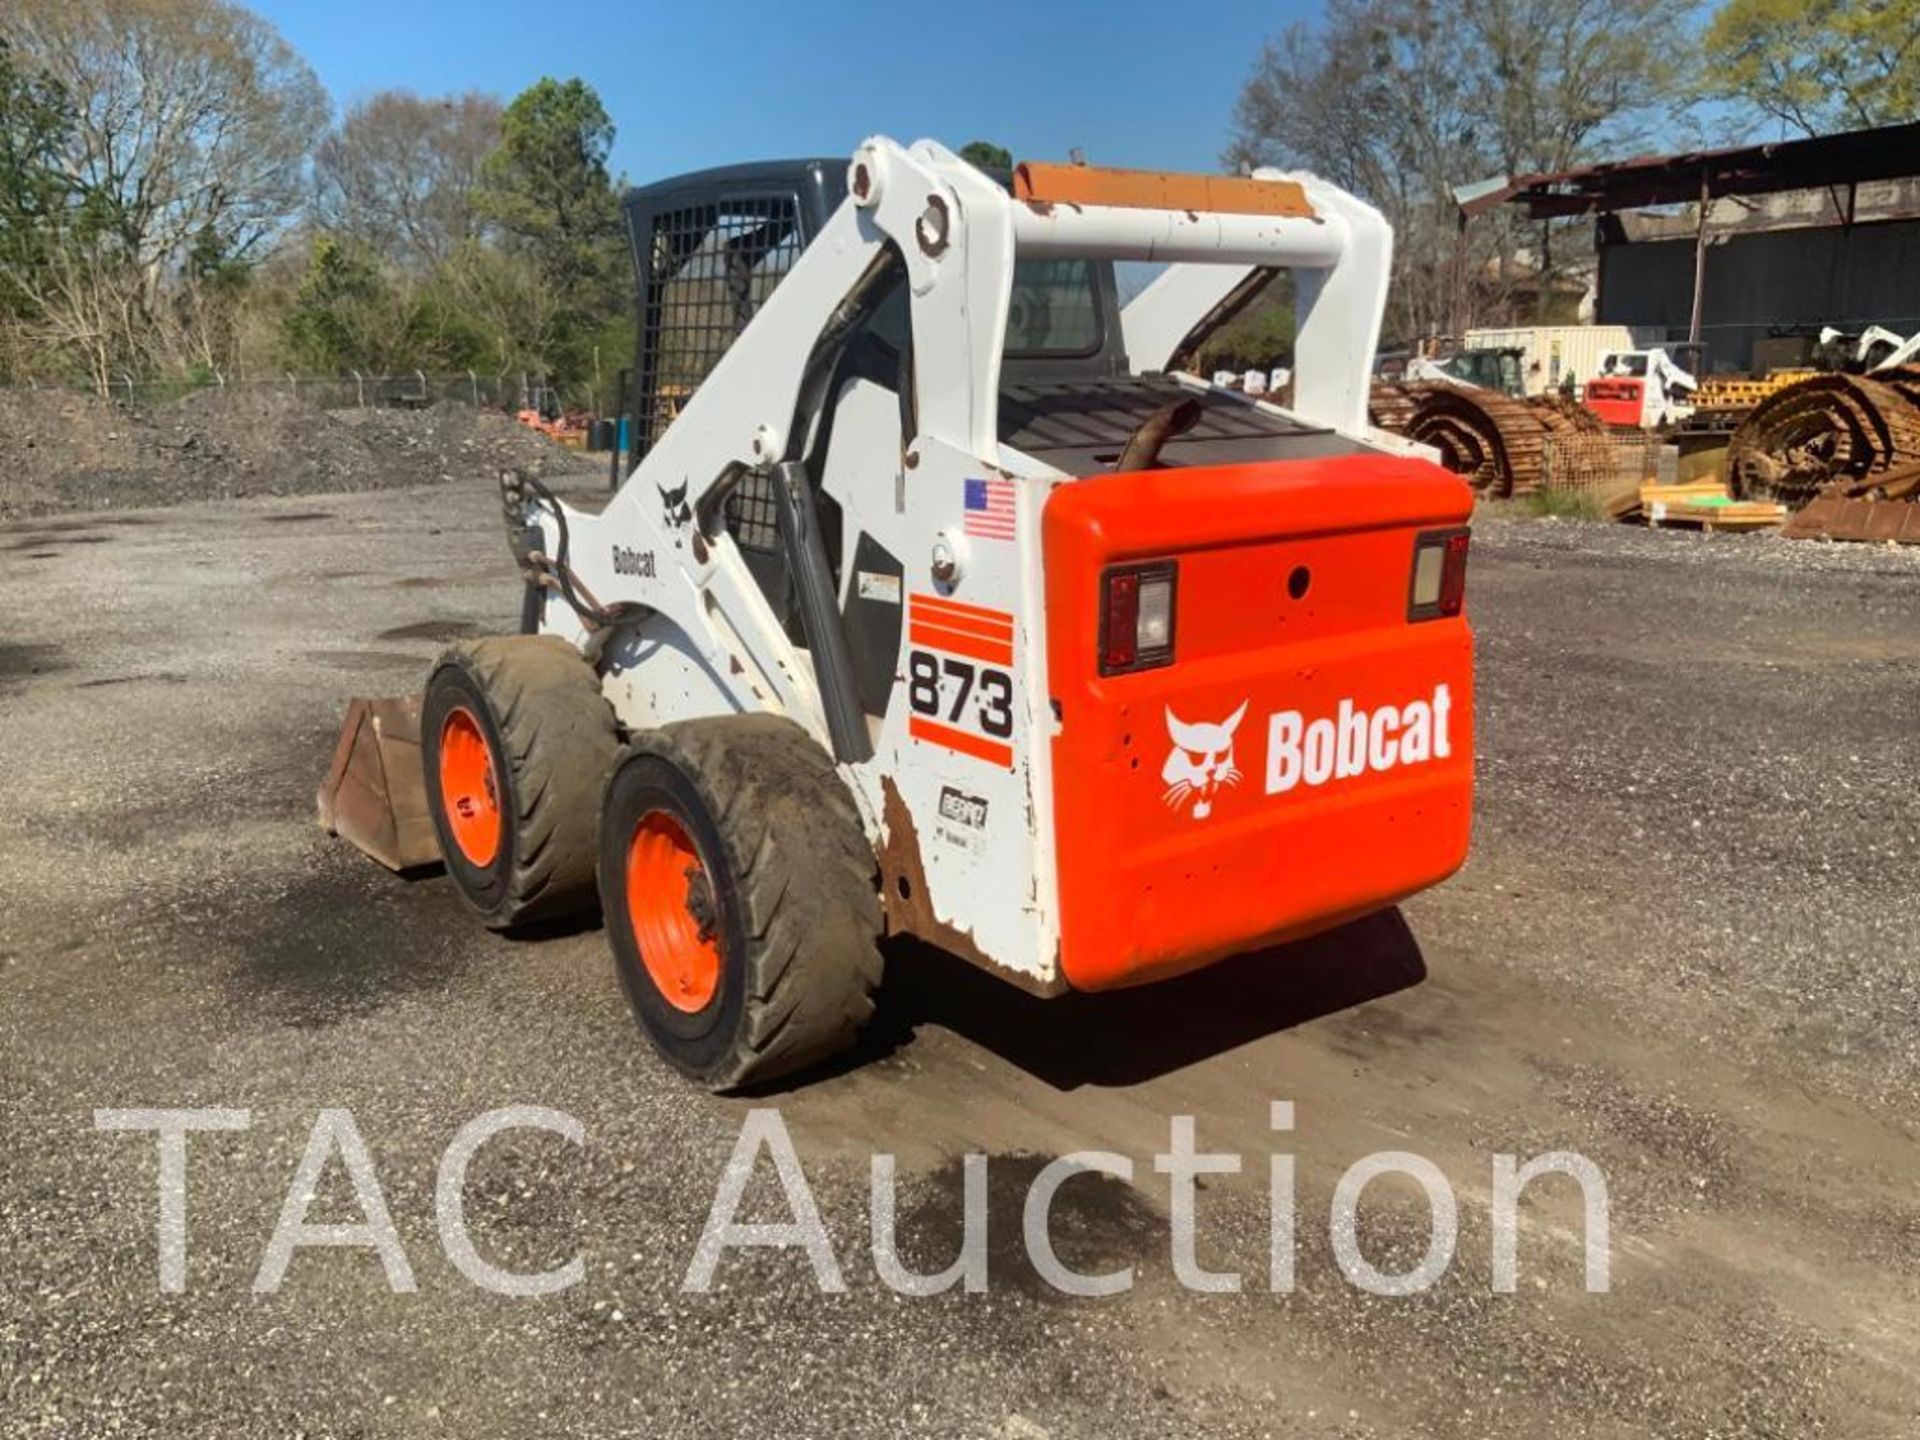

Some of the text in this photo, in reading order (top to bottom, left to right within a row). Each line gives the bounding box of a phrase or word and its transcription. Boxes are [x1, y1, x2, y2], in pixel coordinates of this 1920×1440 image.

[612, 545, 657, 578] Bobcat
[909, 651, 1013, 740] 873
[1265, 683, 1451, 795] Bobcat
